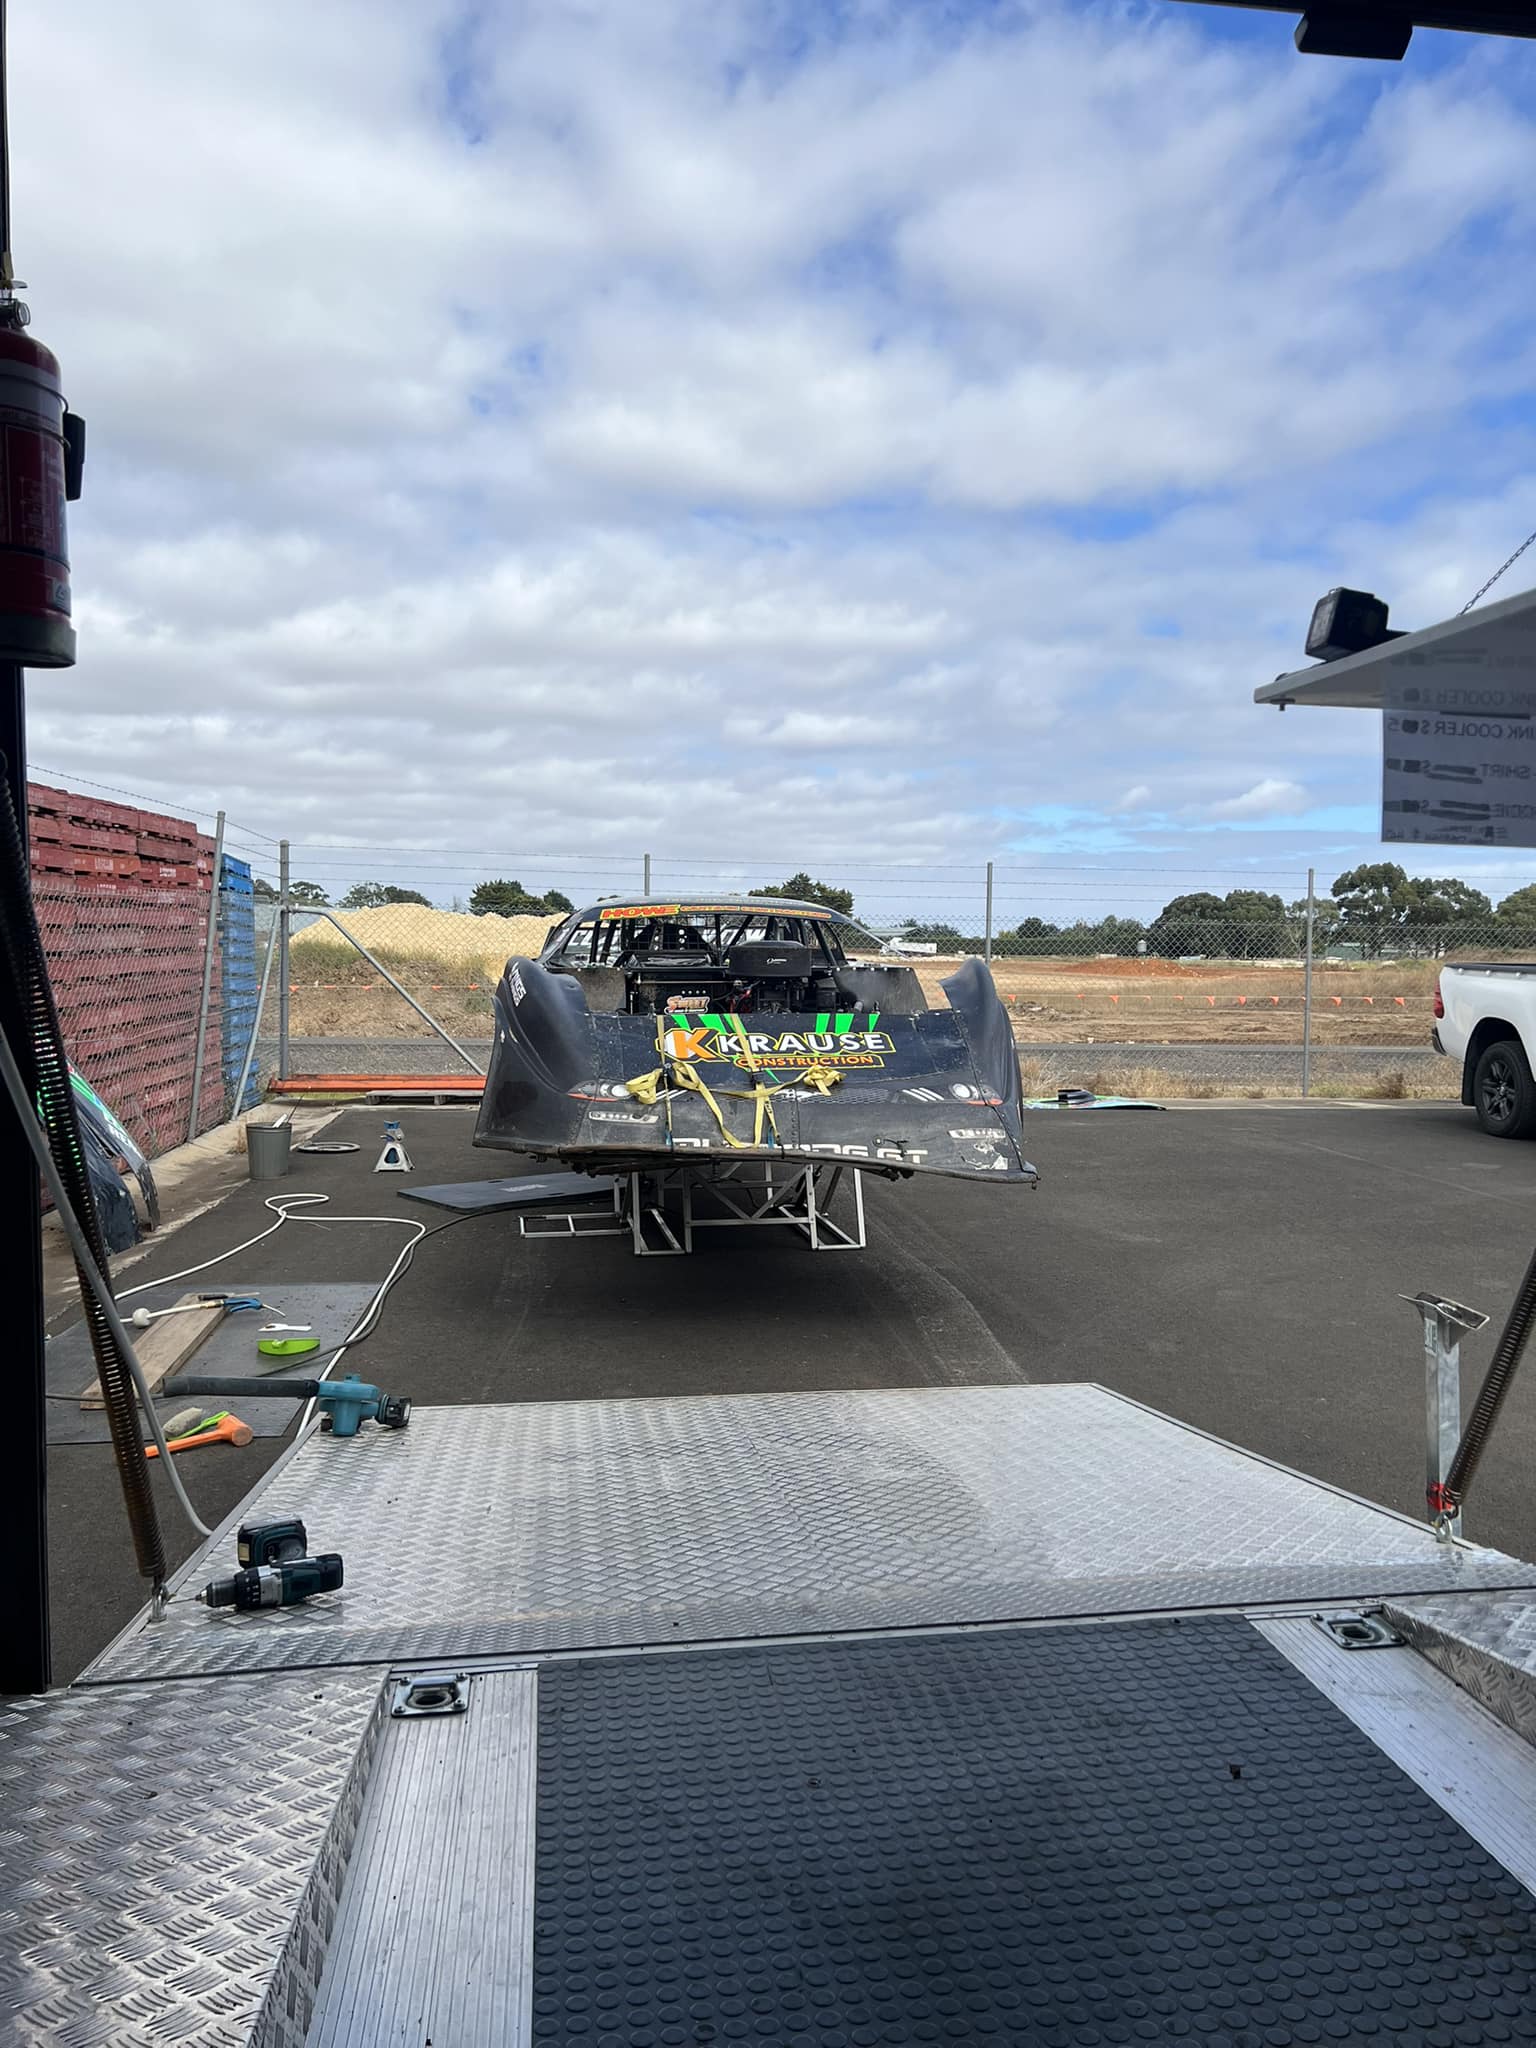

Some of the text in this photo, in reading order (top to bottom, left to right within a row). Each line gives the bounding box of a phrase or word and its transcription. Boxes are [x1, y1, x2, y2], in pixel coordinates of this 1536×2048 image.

[601, 905, 680, 919] HOWE
[718, 1033, 885, 1052] KRAUSE
[737, 1055, 874, 1068] CONSTRUCTION
